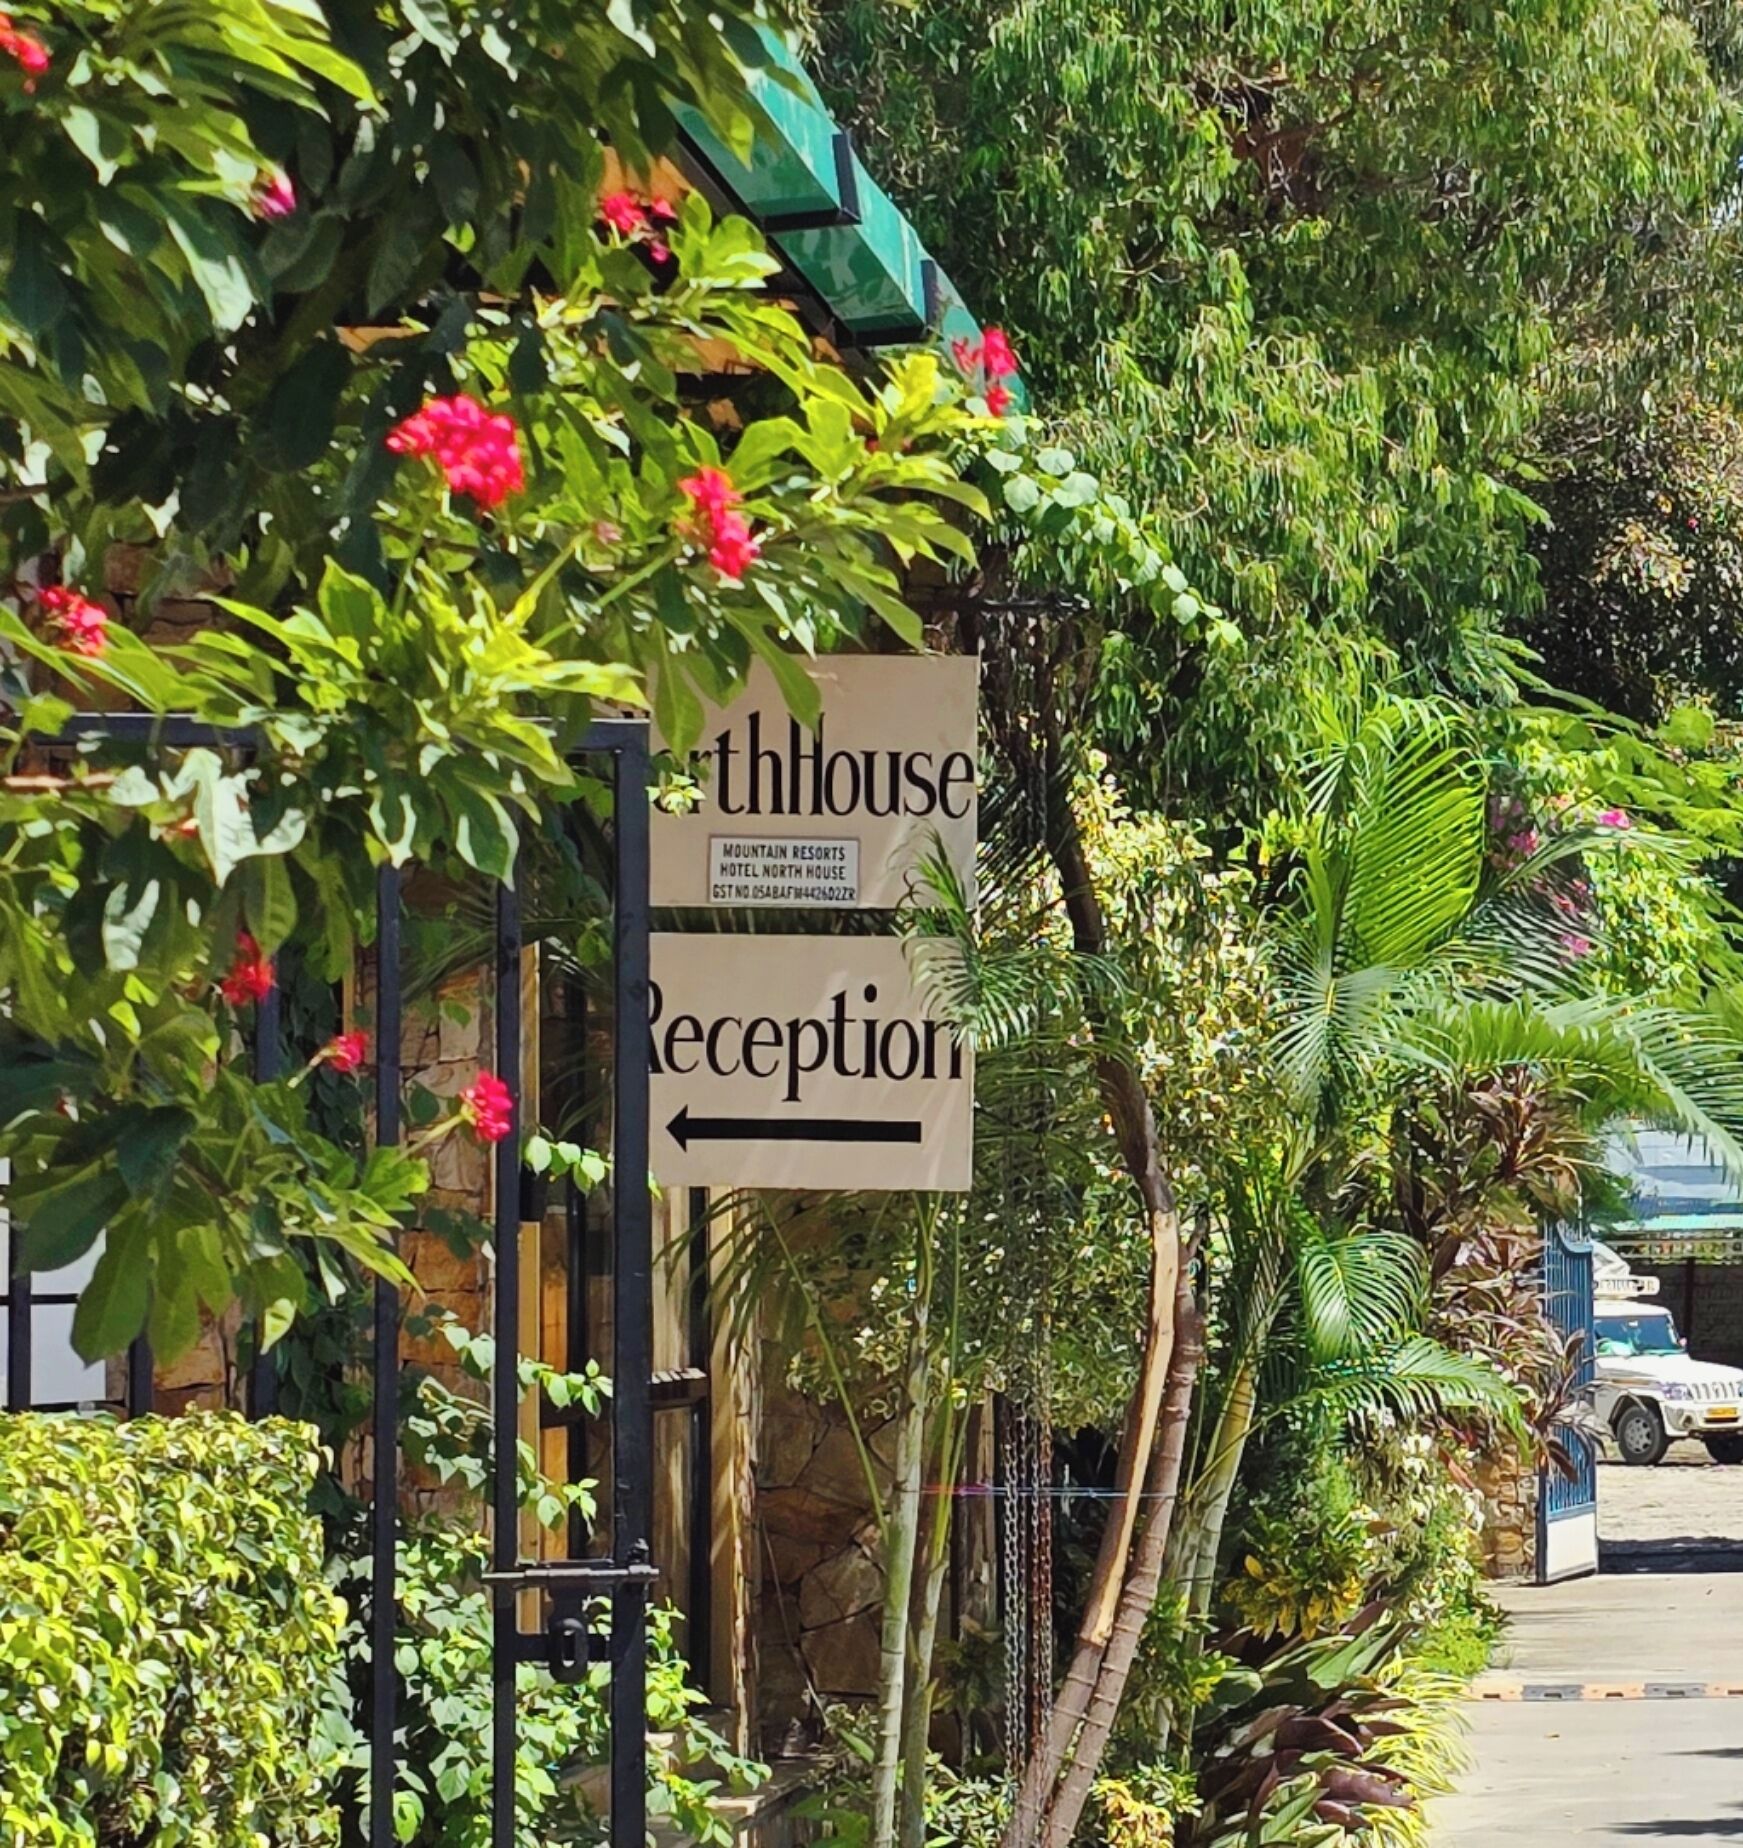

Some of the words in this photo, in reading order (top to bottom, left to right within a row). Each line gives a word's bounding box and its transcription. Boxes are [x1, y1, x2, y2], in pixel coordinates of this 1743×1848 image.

[723, 843, 788, 859] MOUNTAIN
[792, 845, 846, 861] RESORTS
[720, 862, 759, 877] HOTEL
[762, 864, 803, 879] NORTH
[806, 865, 847, 880] HOUSE
